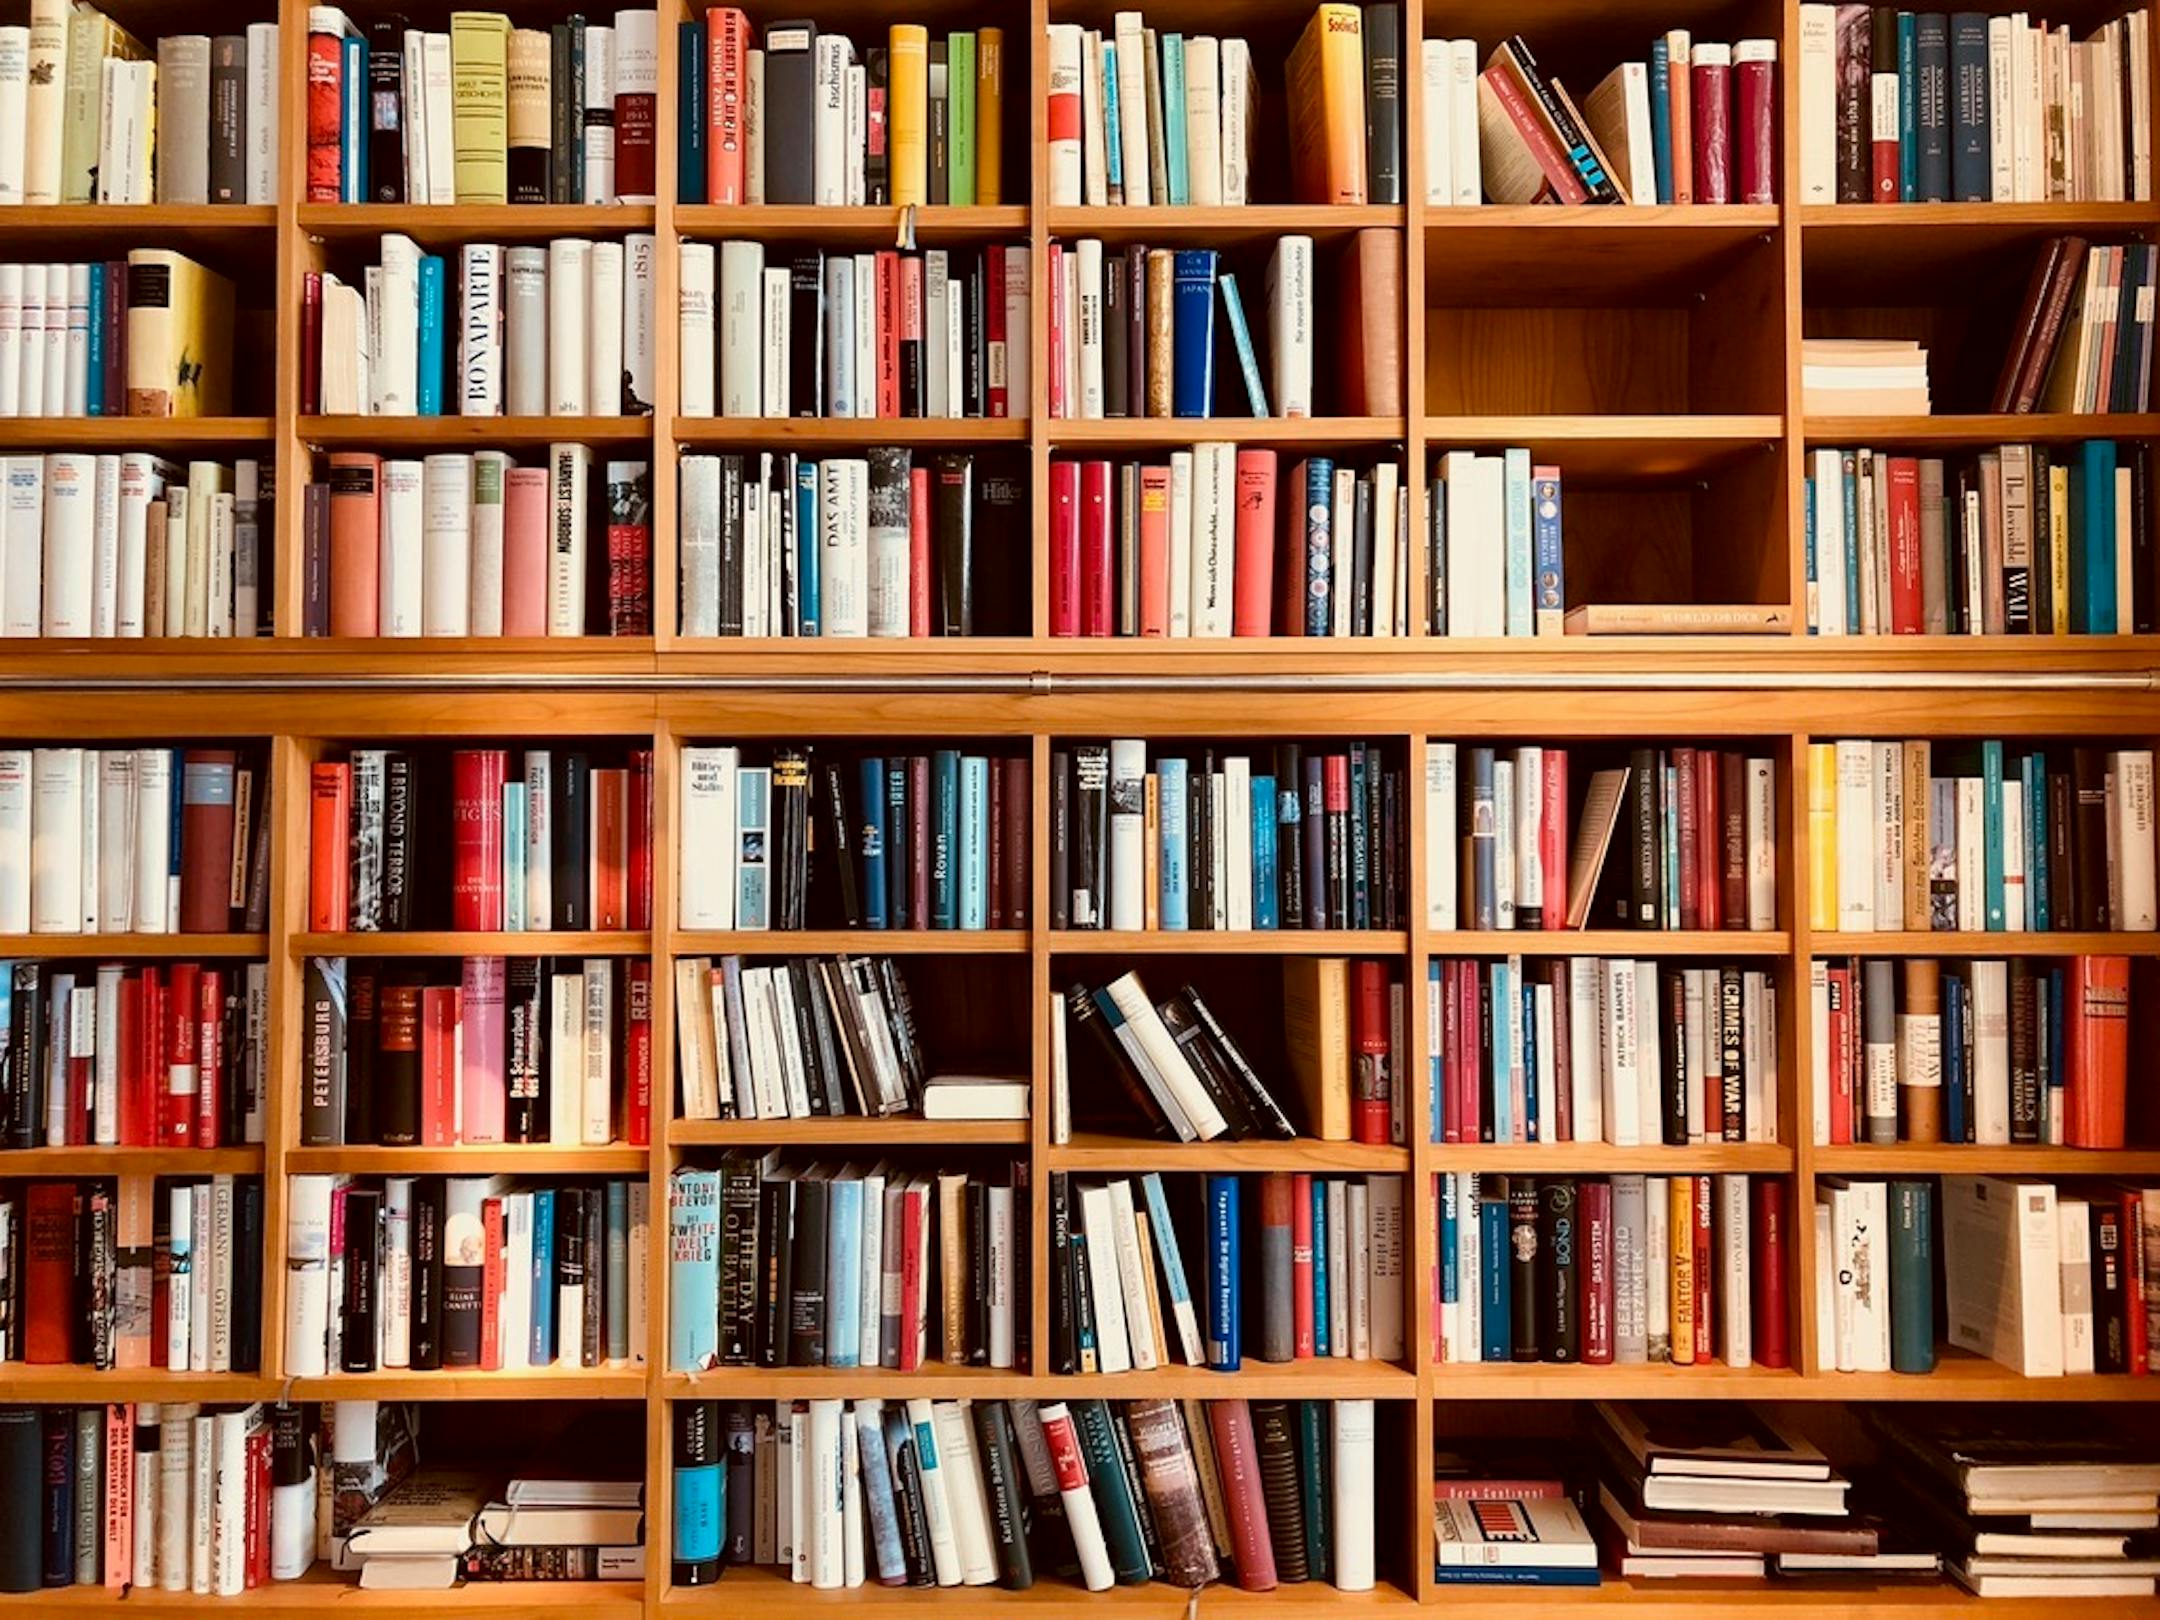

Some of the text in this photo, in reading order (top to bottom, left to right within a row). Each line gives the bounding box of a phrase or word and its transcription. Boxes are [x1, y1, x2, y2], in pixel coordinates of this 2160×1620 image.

[455, 90, 504, 99] GESCHICHTE
[723, 11, 738, 152] DIE ZEIT DER ILLUSIONEN
[828, 43, 842, 109] Faschismus
[1921, 66, 1930, 126] JAHRBUCH
[1936, 67, 1945, 126] YEARBOOK
[1960, 64, 1970, 124] JAHRBUCH
[1974, 66, 1983, 124] YEARBOOK
[712, 87, 722, 126] HEINZ
[636, 244, 649, 280] 1815
[1182, 284, 1210, 294] JAPAN
[1294, 245, 1305, 344] Die neuen Großmächte
[467, 249, 490, 401] BONAPARTE
[558, 455, 574, 554] HARVEST SORROW
[827, 466, 839, 546] DAS AMT
[2008, 475, 2028, 564] The Invisible
[612, 562, 620, 613] ORLANDO
[632, 578, 642, 613] EINES
[1208, 542, 1218, 610] Wenn sich China
[2009, 572, 2029, 627] WALL
[622, 596, 632, 613] DIE
[691, 761, 723, 771] Hitler
[691, 782, 723, 792] Stalin
[697, 772, 717, 782] und
[890, 771, 904, 806] TÄTER
[453, 806, 504, 822] FIGES
[1680, 754, 1690, 842] TERRA ISLAMICA
[388, 776, 407, 896] BEYOND TERROR
[934, 834, 946, 879] Rovan
[1354, 836, 1364, 882] DISASTER
[1728, 814, 1742, 880] Der große Türke
[631, 980, 647, 1020] RED
[1616, 972, 1625, 1068] PATRICK BAHNERS
[1626, 972, 1636, 1046] PANIKMACHER
[313, 1001, 330, 1107] PETERSBURG
[510, 1006, 524, 1098] Das Schwarzbuch
[638, 1036, 648, 1106] BILL BROWDER
[1723, 984, 1740, 1113] CRIMES OF WAR
[1916, 1022, 1926, 1078] ZWEITE
[1928, 1022, 1940, 1078] WELT
[2014, 1067, 2024, 1122] JONATHAN
[2025, 1068, 2036, 1120] SCHELL
[670, 1196, 716, 1207] BEEVOR
[671, 1182, 715, 1195] ANTONY
[1220, 1190, 1230, 1238] Tapscott
[1700, 1177, 1711, 1229] campus
[669, 1223, 716, 1236] ZWEITE
[676, 1236, 709, 1249] WELT
[1056, 1197, 1068, 1248] The Tories
[1374, 1206, 1386, 1276] George Packer
[1390, 1206, 1400, 1276] Die Abwicklung
[1556, 1218, 1570, 1264] BOND
[1733, 1182, 1743, 1272] KONRAD LORENZ
[214, 1188, 228, 1344] GERMANY GYPSIES
[674, 1249, 711, 1262] KRIEG
[722, 1212, 740, 1336] OF BATTLE
[738, 1228, 752, 1325] THE DAY
[1220, 1255, 1230, 1286] digitale
[1592, 1220, 1601, 1284] DAS SYSTEM
[399, 1254, 408, 1317] FREIE WELT
[443, 1301, 482, 1310] CANETTI
[449, 1293, 475, 1301] ELIAS
[1558, 1270, 1566, 1308] McTaggart
[1618, 1225, 1630, 1338] BERNHARD
[1634, 1249, 1646, 1336] GRZIMEK
[1677, 1256, 1692, 1324] FAKTOR V
[1220, 1288, 1230, 1334] Revolution
[687, 1416, 695, 1454] CLAUDE
[695, 1406, 704, 1462] LANZMANN
[1228, 1418, 1244, 1480] Königsberg
[80, 1424, 95, 1558] Mario Frank Gauck
[120, 1447, 128, 1499] HANDBUCH
[200, 1421, 208, 1518] Silverstone Mediapolis
[992, 1446, 1014, 1544] Karl Heinz Bohrer
[1450, 1487, 1545, 1498] Dark Continent
[109, 1522, 117, 1542] WELT
[110, 1501, 118, 1520] DER
